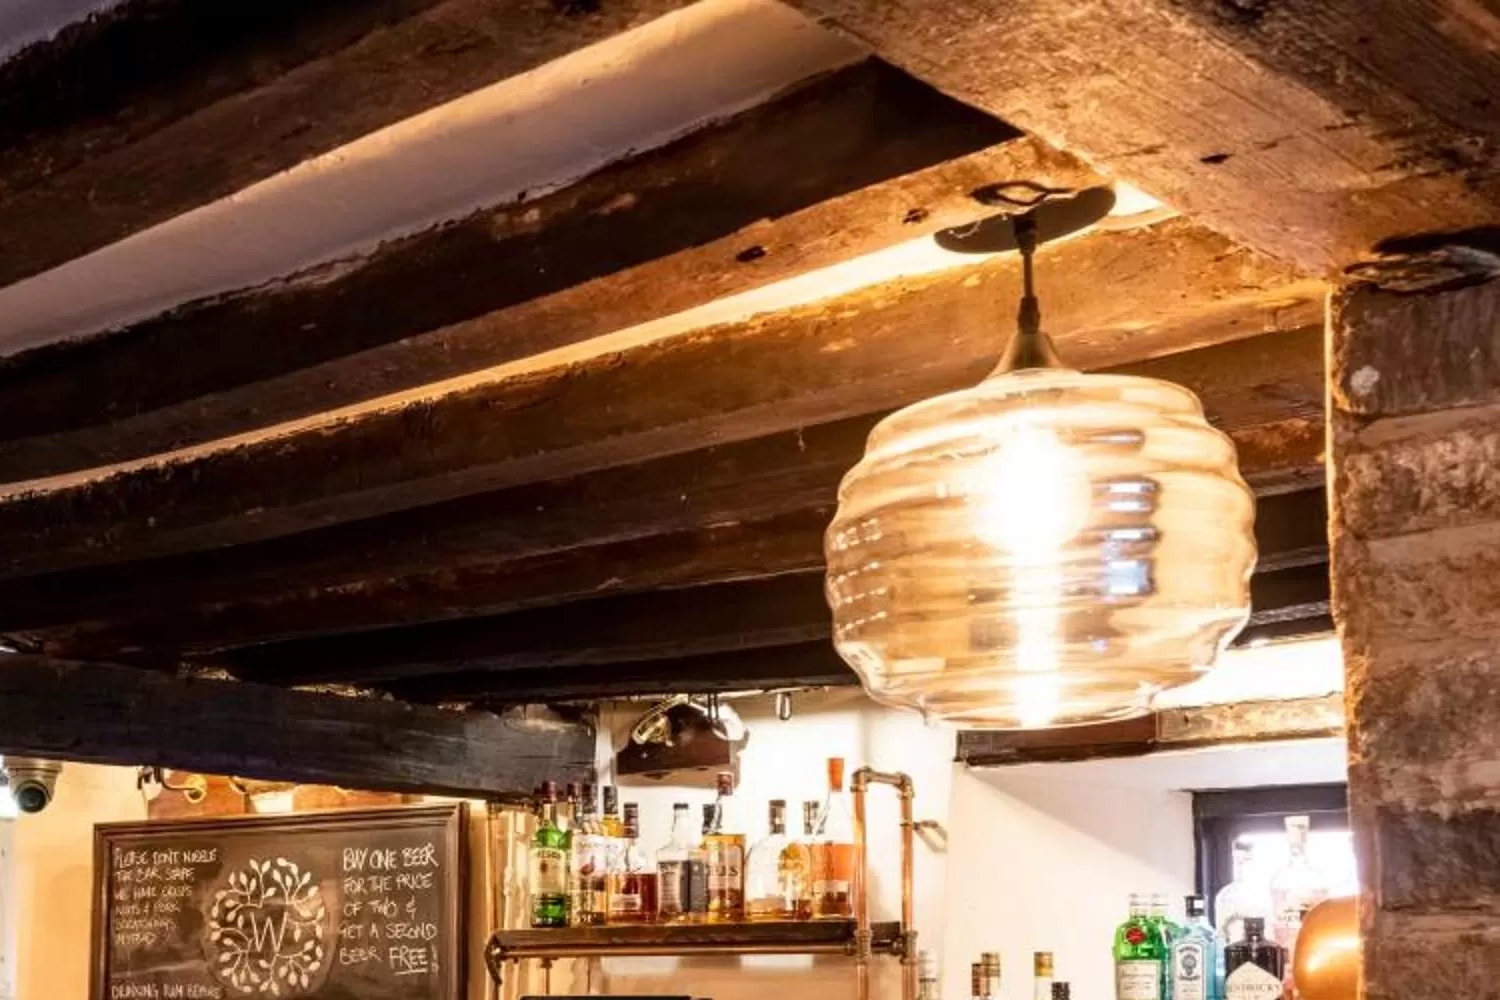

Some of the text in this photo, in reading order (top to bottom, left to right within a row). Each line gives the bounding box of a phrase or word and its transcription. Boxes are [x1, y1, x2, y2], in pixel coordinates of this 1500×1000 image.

[343, 842, 439, 871] BUY ONE BEER
[343, 872, 433, 895] FOR THE PRICE
[343, 900, 363, 917] OF
[367, 895, 398, 918] TWO
[250, 911, 289, 953] W
[338, 921, 438, 941] GET A SECOND
[340, 945, 382, 965] BEER
